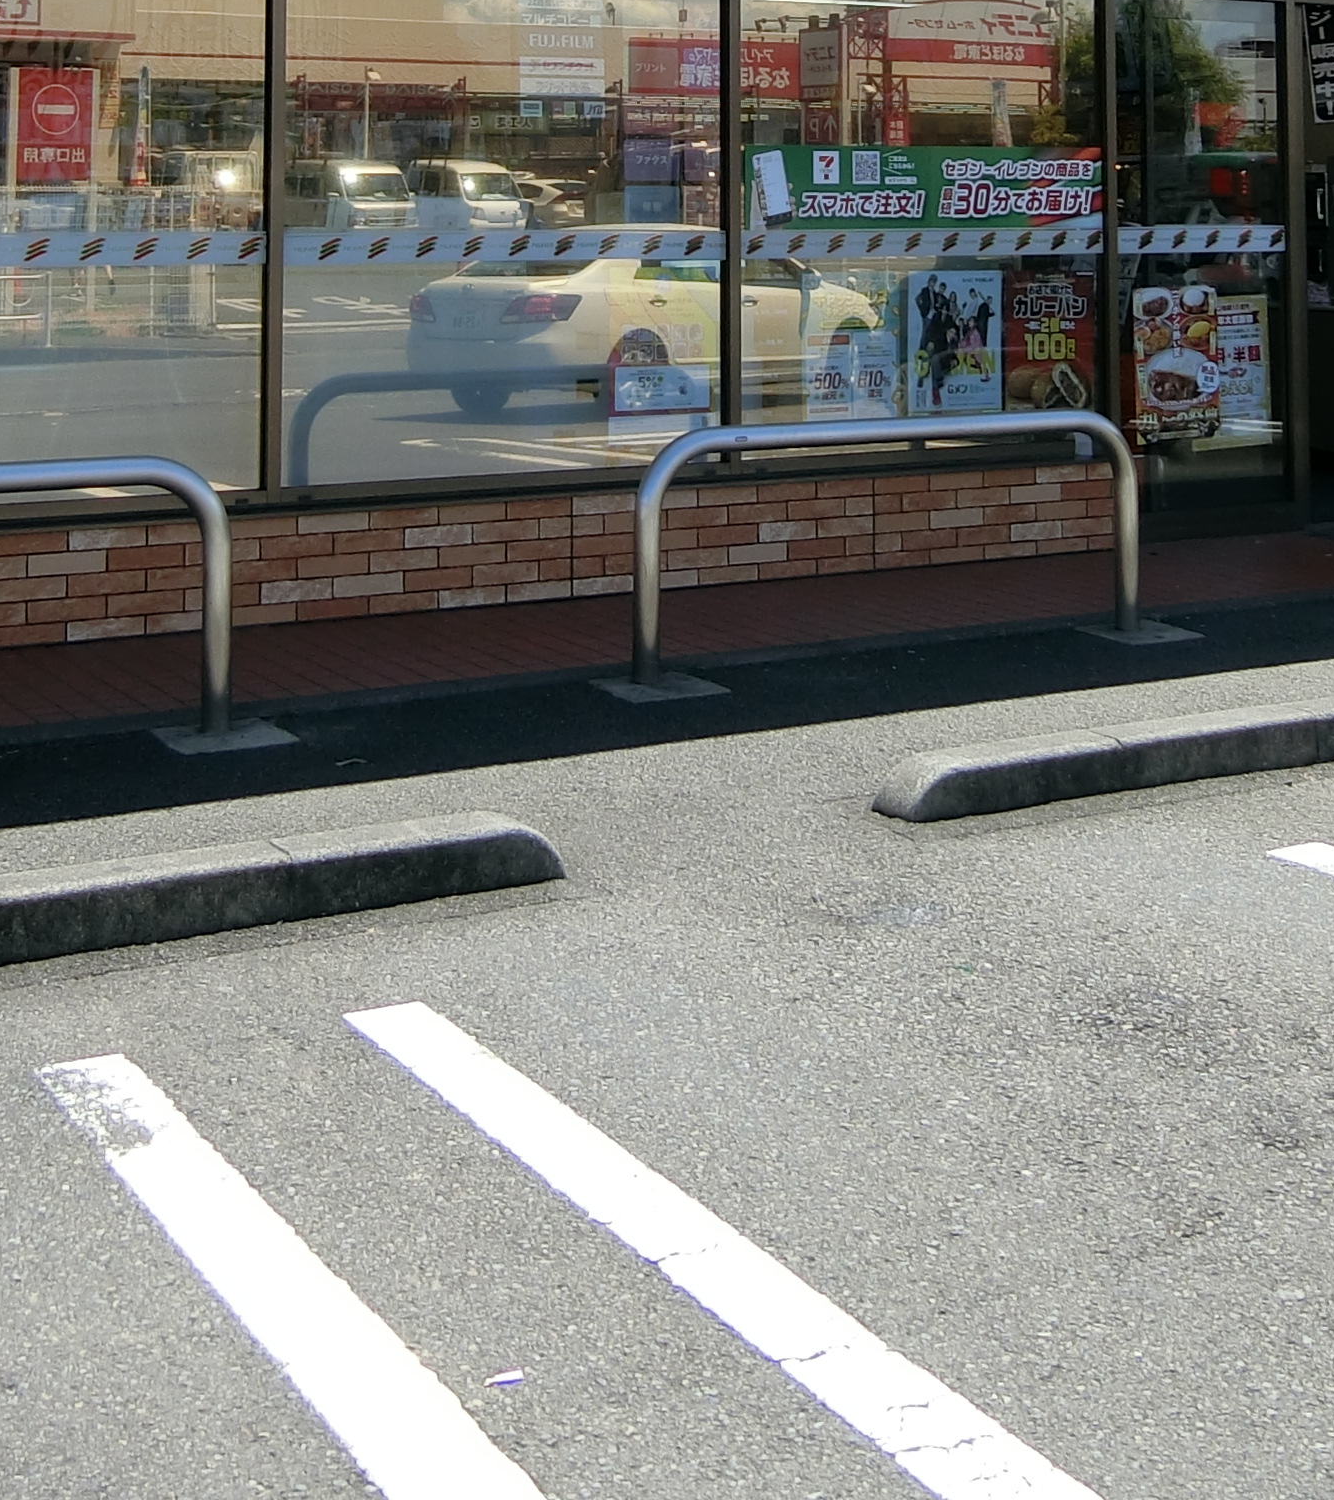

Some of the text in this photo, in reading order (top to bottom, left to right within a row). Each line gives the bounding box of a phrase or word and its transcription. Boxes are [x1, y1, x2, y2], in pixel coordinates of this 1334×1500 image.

[635, 61, 667, 74] プリント
[1013, 295, 1088, 318] カレーパン
